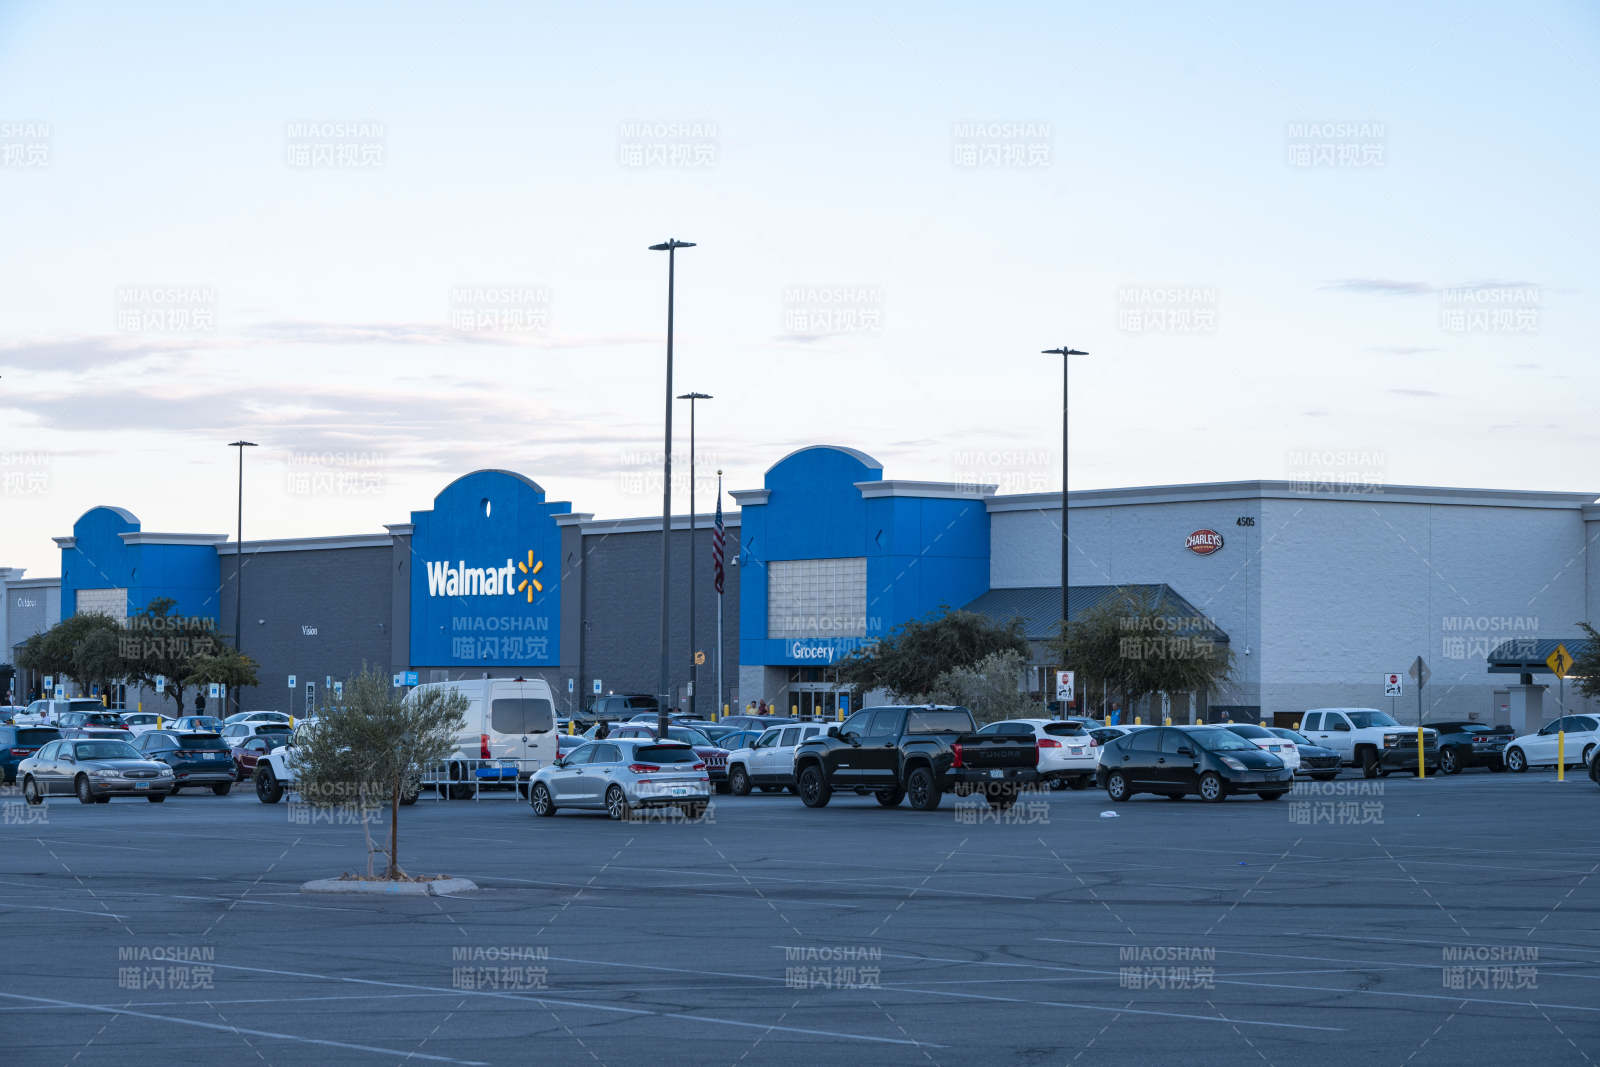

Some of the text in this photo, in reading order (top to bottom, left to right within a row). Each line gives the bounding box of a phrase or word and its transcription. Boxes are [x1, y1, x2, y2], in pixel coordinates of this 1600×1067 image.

[1236, 516, 1255, 527] 4505
[1184, 534, 1223, 548] CHARLEYS
[426, 558, 516, 597] Walmart
[301, 625, 318, 636] Vision
[792, 641, 834, 664] Grocery
